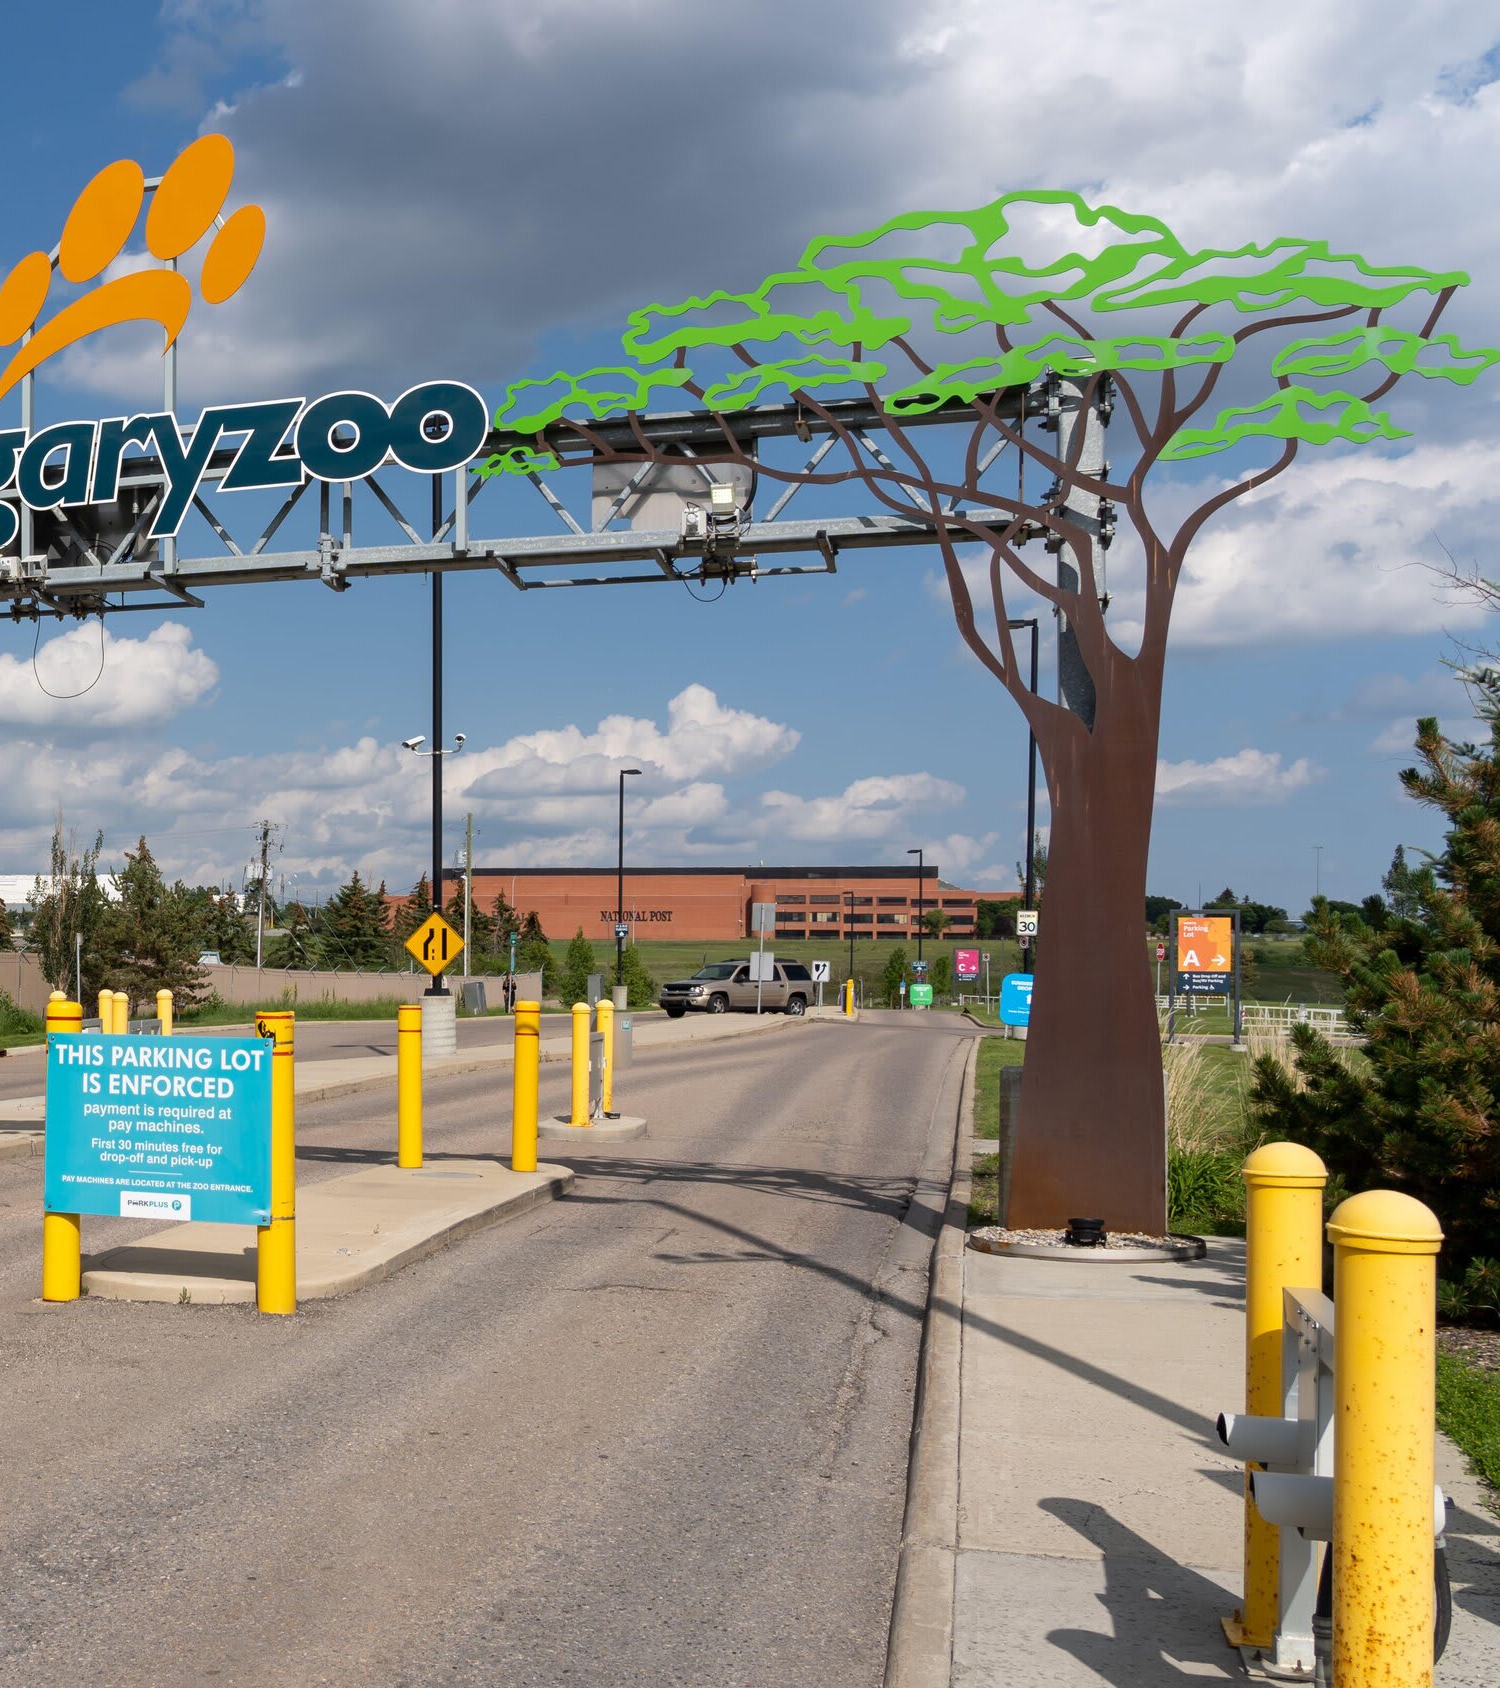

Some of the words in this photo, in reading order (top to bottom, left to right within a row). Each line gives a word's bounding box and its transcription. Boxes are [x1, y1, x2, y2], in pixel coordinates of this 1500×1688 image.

[600, 910, 648, 922] NATONAL
[649, 910, 673, 922] POST
[1019, 921, 1035, 932] 30
[1183, 949, 1201, 966] A
[958, 963, 966, 972] C
[55, 1043, 104, 1066] THIS
[111, 1045, 213, 1070] PARKING
[220, 1048, 265, 1072] LOT
[82, 1072, 102, 1094] IS
[108, 1073, 235, 1099] ENFORCED
[83, 1103, 141, 1118] payment
[143, 1103, 155, 1117] is
[158, 1105, 215, 1120] required
[218, 1107, 232, 1120] at
[108, 1119, 133, 1134] pay
[136, 1119, 205, 1134] machines.
[91, 1137, 116, 1150] First
[118, 1139, 132, 1150] 30
[134, 1140, 179, 1153] minutes
[181, 1142, 204, 1154] free
[206, 1143, 223, 1155] for
[99, 1151, 144, 1165] drop-off
[146, 1154, 168, 1165] and
[170, 1155, 213, 1169] pick-up
[62, 1174, 75, 1183] PAY
[76, 1175, 114, 1185] MACHINES
[115, 1178, 130, 1186] ARE
[131, 1179, 165, 1188] LOCATED
[165, 1180, 176, 1188] AT
[176, 1182, 192, 1190] THE
[192, 1183, 210, 1191] ZOO
[210, 1183, 253, 1193] ENTRANCE.
